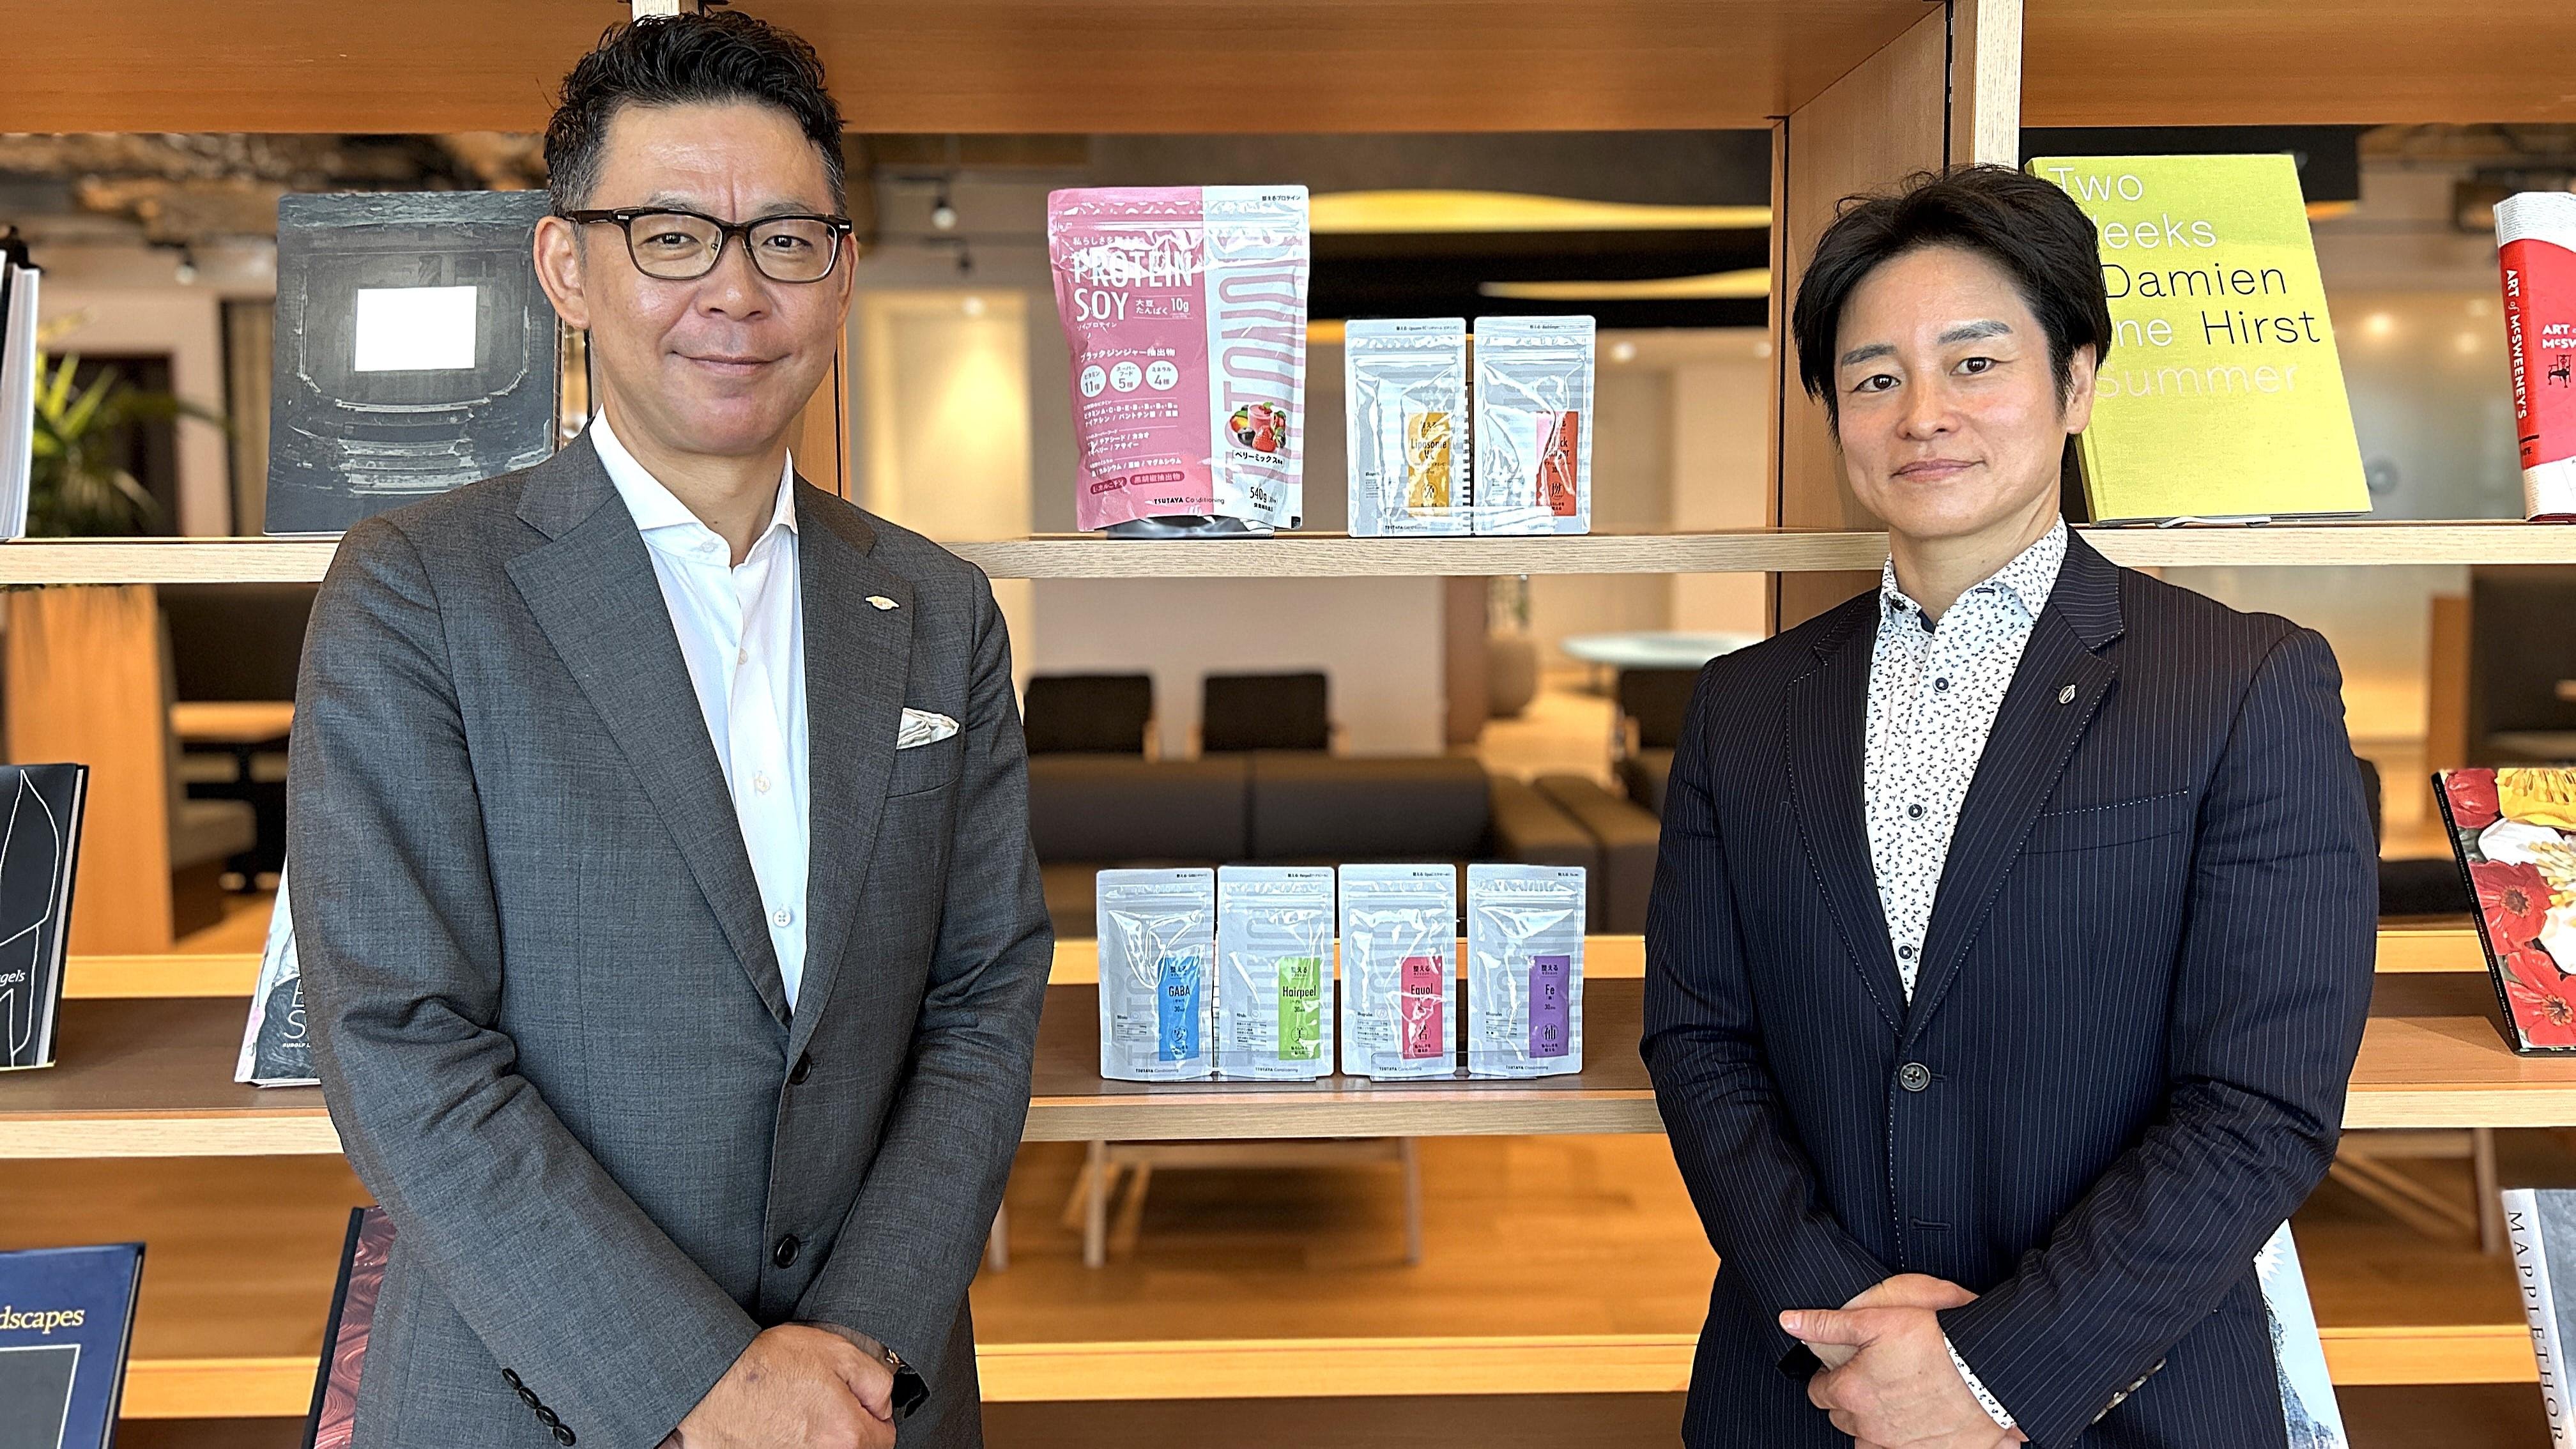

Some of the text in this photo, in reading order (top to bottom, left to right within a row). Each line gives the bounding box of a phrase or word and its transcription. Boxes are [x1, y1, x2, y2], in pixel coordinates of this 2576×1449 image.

[2047, 167, 2143, 201] Two
[2092, 213, 2218, 250] eeks
[1073, 250, 1193, 288] PROTEIN
[2101, 263, 2287, 298] Damien
[2506, 270, 2520, 297] ART
[1073, 288, 1130, 322] SOY
[1135, 299, 1154, 307] 大豆
[1136, 307, 1168, 315] たんぱく
[1170, 298, 1190, 312] 10g
[2508, 301, 2520, 312] of
[2115, 318, 2173, 347] ne
[2202, 310, 2321, 345] Hirst
[2542, 323, 2571, 335] ART
[2096, 364, 2299, 399] Summer
[1250, 486, 1267, 503] 540g
[0, 969, 26, 987] gels
[1169, 985, 1191, 997] GABA
[1282, 985, 1317, 999] Hairpeel
[1411, 983, 1433, 995] Equol
[1545, 984, 1555, 995] Fe
